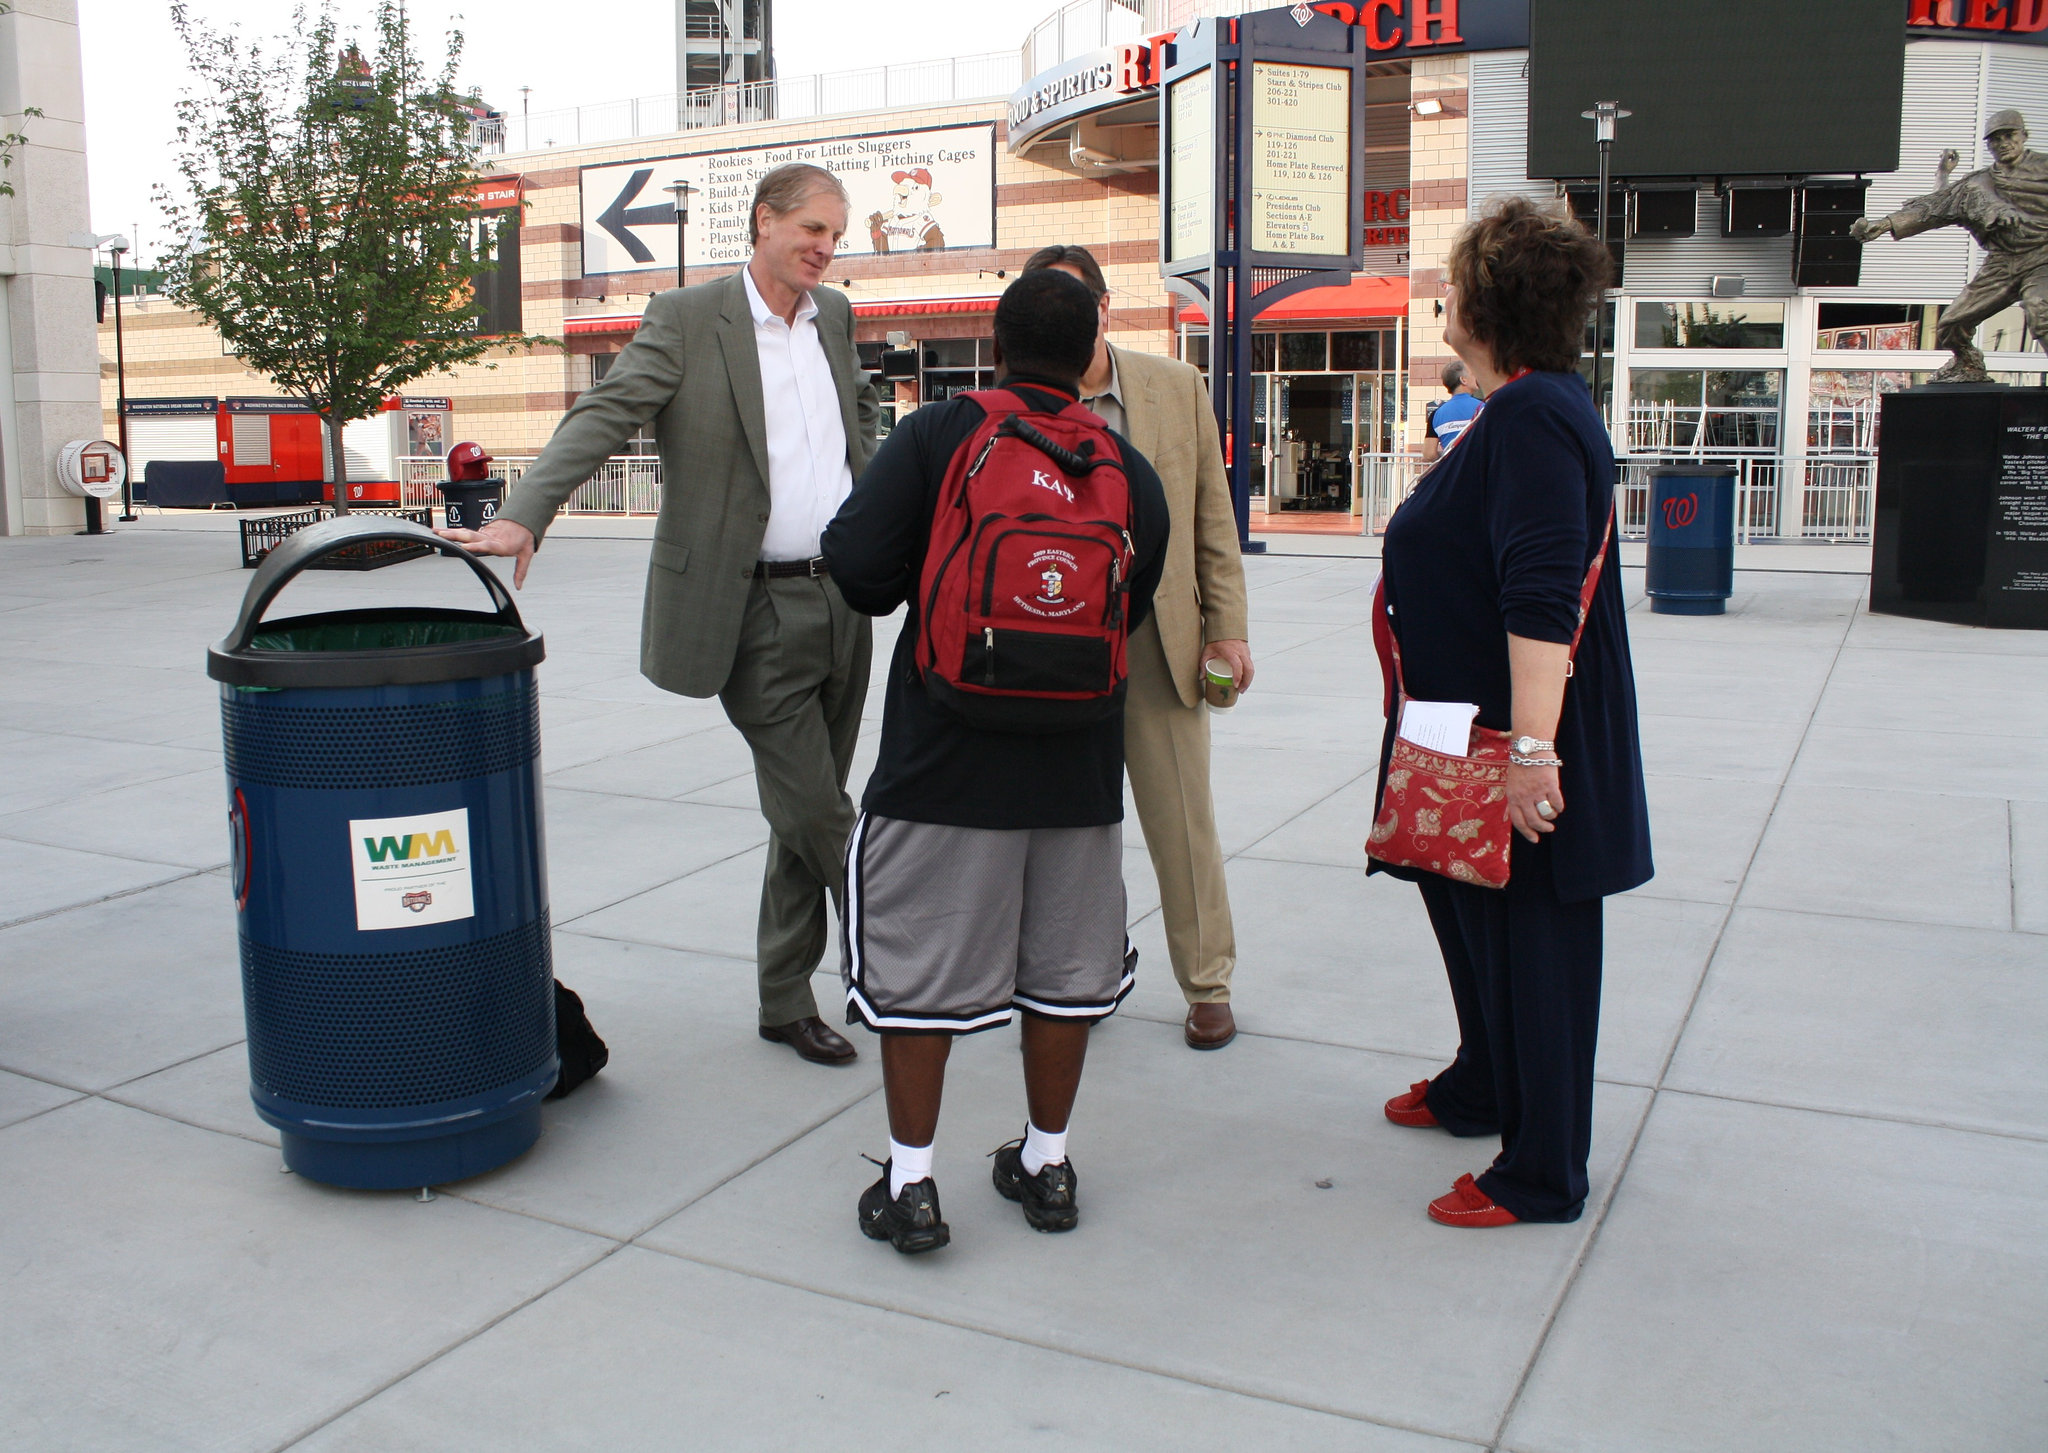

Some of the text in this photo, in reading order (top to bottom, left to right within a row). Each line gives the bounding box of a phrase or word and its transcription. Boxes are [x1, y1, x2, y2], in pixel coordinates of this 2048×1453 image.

[1267, 68, 1309, 78] Suites 1-79
[1267, 78, 1286, 86] Stars
[1298, 80, 1323, 90] Stripes
[1326, 82, 1342, 91] Club
[1008, 63, 1112, 131] FOOD & SPIRITS
[1267, 88, 1297, 97] 206-221
[1267, 98, 1298, 107] 301-420
[1286, 132, 1316, 141] Diamond
[1318, 134, 1334, 143] Club
[1267, 140, 1298, 150] 119-126
[708, 139, 911, 169] Rookies Food For Little Sluggers
[1266, 150, 1297, 159] 201-221
[708, 171, 742, 184] Exxon
[826, 159, 870, 172] Batting
[882, 152, 934, 168] Pitching
[938, 149, 976, 163] Cages
[1266, 160, 1344, 172] Home Plate Reserved
[1273, 170, 1332, 181] 119, 120 & 126
[487, 189, 516, 200] STAIR
[709, 200, 752, 214] Kids Pla
[1266, 202, 1321, 212] Presidents Club
[1364, 188, 1410, 220] RC
[1266, 212, 1297, 220] Sections
[709, 216, 746, 230] Family
[1266, 221, 1300, 230] Elevators
[709, 231, 751, 246] Playsta
[1266, 231, 1287, 239] Home
[1289, 232, 1308, 240] Plate
[709, 247, 740, 259] Geico
[1046, 549, 1075, 561] EASTERN
[1027, 555, 1078, 572] PROVINCE COUNCIL
[1048, 601, 1085, 617] MARYLAND
[363, 829, 456, 863] WM
[401, 856, 457, 868] MANAGEMENT
